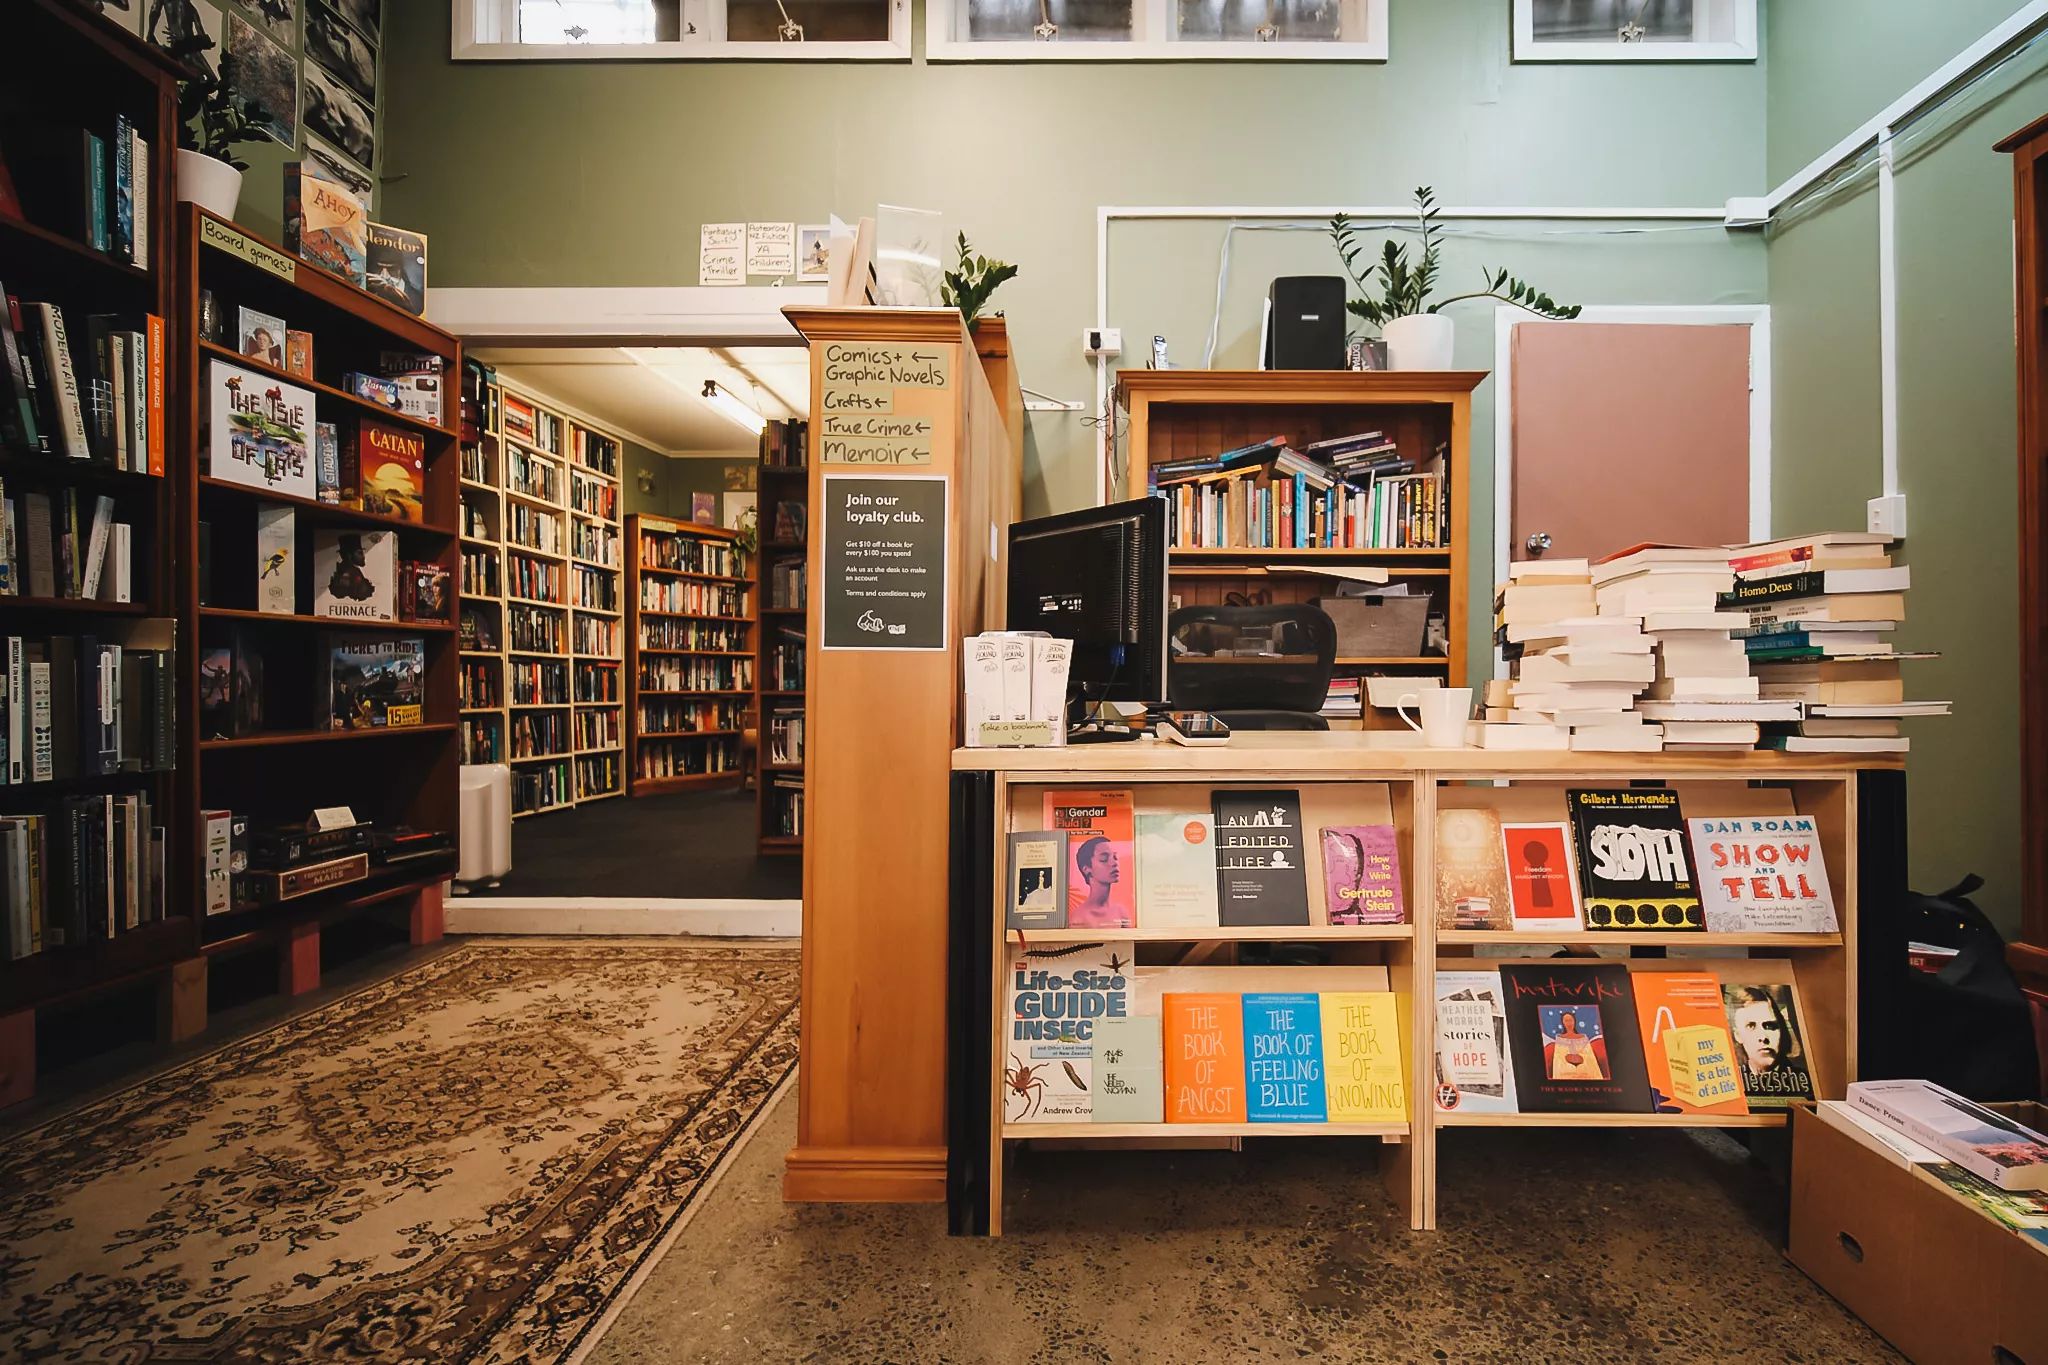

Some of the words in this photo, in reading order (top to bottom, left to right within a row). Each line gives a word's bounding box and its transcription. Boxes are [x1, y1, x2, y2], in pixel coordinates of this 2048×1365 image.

[313, 188, 356, 222] AHOY
[204, 218, 245, 253] Board
[250, 247, 288, 272] games
[367, 226, 420, 253] lendor
[756, 245, 770, 254] YA
[703, 254, 735, 265] Crime
[51, 305, 72, 369] MODERN
[154, 366, 160, 377] IN
[826, 364, 885, 387] Graphic
[890, 363, 945, 386] Novels
[61, 370, 77, 398] ART
[225, 382, 262, 416] THE
[265, 397, 304, 430] ISLE
[824, 391, 872, 409] Crafts
[825, 416, 862, 435] True
[866, 418, 913, 436] Crime
[369, 428, 417, 457] CATAN
[824, 440, 908, 464] Memoir
[231, 440, 258, 466] OF
[265, 447, 305, 481] CATS
[323, 442, 337, 483] CITADELS
[846, 493, 872, 507] Join
[875, 496, 899, 506] our
[846, 510, 889, 525] loyalty
[893, 511, 925, 523] club.
[845, 540, 858, 548] Get
[859, 540, 871, 549] $10
[872, 540, 881, 548] off
[845, 551, 862, 559] every
[864, 549, 879, 558] $100
[893, 549, 912, 558] spend
[886, 566, 901, 574] desk
[845, 589, 865, 597] Terms
[910, 590, 927, 599] apply
[1739, 585, 1768, 598] Homo
[1768, 582, 1793, 594] Deus
[329, 605, 377, 617] FURNACE
[339, 643, 381, 655] TICKET
[383, 643, 392, 652] TO
[389, 708, 402, 725] 15
[981, 723, 1000, 732] Take
[1011, 722, 1048, 731] bookmark
[1580, 793, 1616, 804] Gilbert
[1622, 793, 1675, 804] Hernandez
[1069, 807, 1105, 817] Gender
[1228, 816, 1248, 826] AN
[1703, 821, 1742, 833] DAN
[1752, 819, 1812, 832] ROAM
[1228, 836, 1289, 847] EDITED
[1370, 855, 1390, 864] How
[1590, 824, 1689, 881] SLOTH
[1711, 842, 1810, 868] SHOW
[1229, 857, 1265, 867] LIFE
[313, 870, 344, 885] MARS
[1369, 871, 1391, 880] Write
[1339, 887, 1393, 899] Gertrude
[1721, 873, 1818, 901] TELL
[1366, 899, 1395, 911] Stein
[1015, 970, 1126, 991] Life-Size
[1511, 975, 1624, 999] matariki
[1015, 992, 1126, 1018] GUIDE
[1441, 1006, 1486, 1014] HEATHER
[1184, 1006, 1218, 1030] THE
[1266, 1010, 1295, 1031] THE
[1339, 1006, 1373, 1028] THE
[1446, 1017, 1484, 1026] MORRIS
[1014, 1020, 1092, 1041] INSEC
[1443, 1027, 1491, 1040] stories
[1184, 1030, 1226, 1060] BOOK
[1253, 1033, 1292, 1058] BOOK
[1295, 1034, 1315, 1056] OF
[1339, 1029, 1382, 1057] BOOK
[1464, 1042, 1473, 1050] OF
[1697, 1039, 1714, 1051] my
[1453, 1053, 1488, 1067] HOPE
[1698, 1053, 1724, 1066] mess
[1107, 1073, 1117, 1081] THE
[1195, 1060, 1216, 1084] OF
[1251, 1060, 1319, 1083] FEELING
[1353, 1058, 1373, 1081] OF
[1696, 1069, 1706, 1082] is
[1708, 1070, 1715, 1080] a
[1715, 1066, 1731, 1078] bit
[1740, 1065, 1809, 1093] ietzsche
[1104, 1087, 1137, 1095] WOMAN
[1260, 1084, 1309, 1108] BLUE
[1328, 1083, 1403, 1111] KNOWING
[1698, 1083, 1709, 1097] of
[1712, 1085, 1718, 1095] a
[1719, 1081, 1736, 1094] life
[1178, 1084, 1234, 1115] ANGST
[1859, 1096, 1881, 1112] Dance
[1883, 1109, 1905, 1126] Prone
